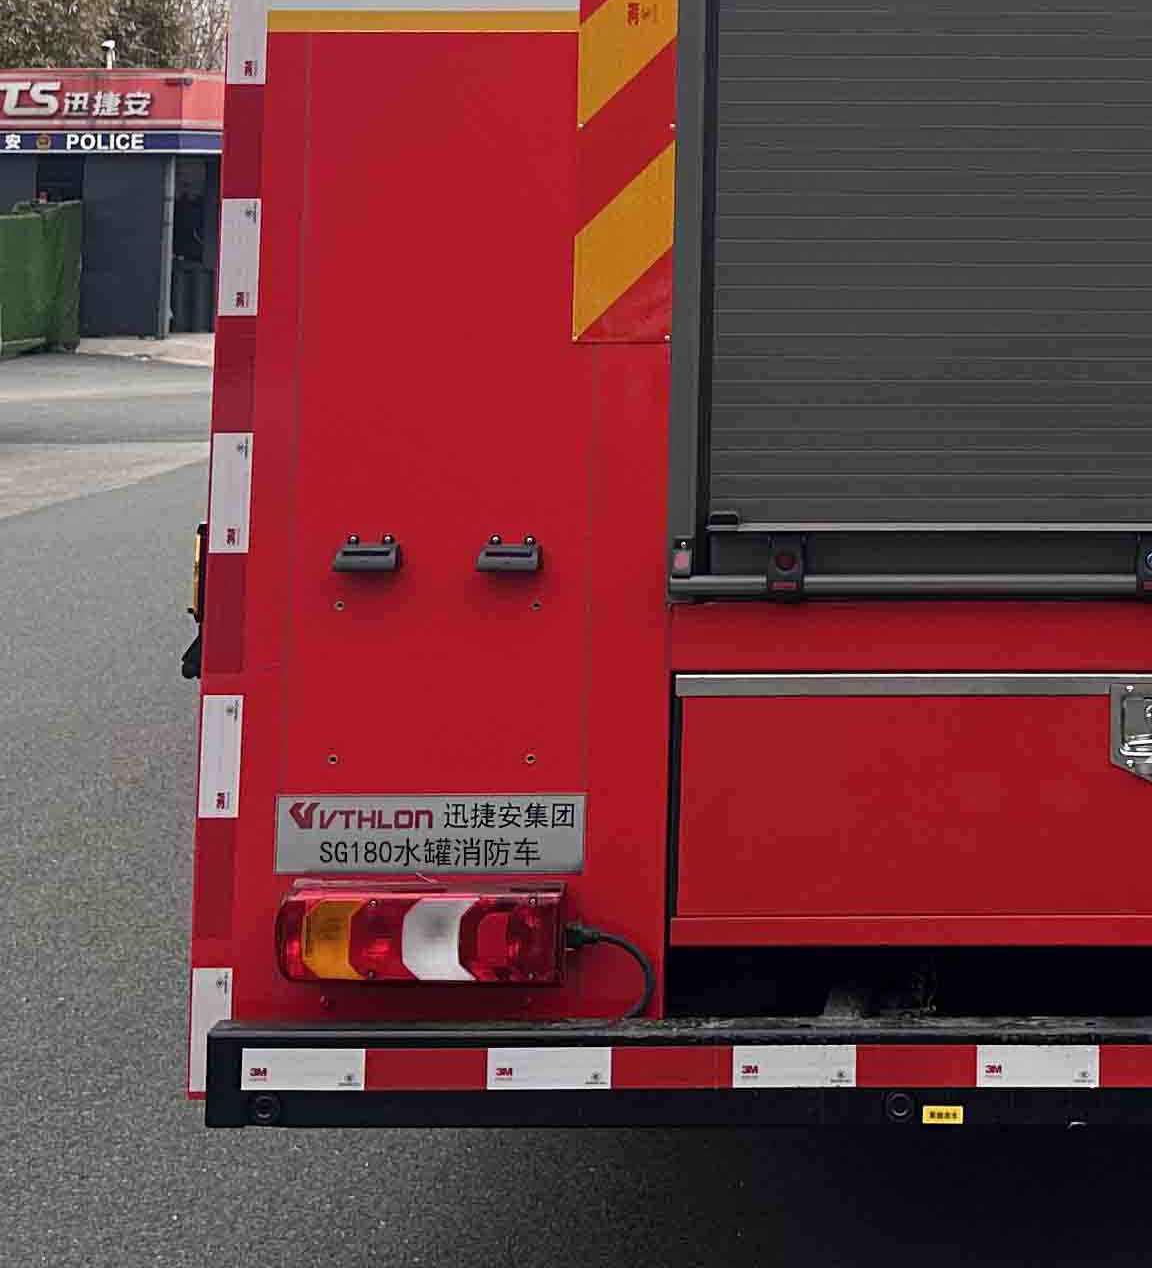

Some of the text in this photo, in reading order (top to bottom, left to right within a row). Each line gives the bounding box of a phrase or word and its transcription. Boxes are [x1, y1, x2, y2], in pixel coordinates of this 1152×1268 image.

[62, 91, 151, 116] 迅捷安
[5, 134, 145, 150] 安 POLICE
[443, 802, 576, 829] 迅捷安集团
[319, 837, 541, 867] SG180水罐消防车
[251, 1068, 267, 1076] 3M
[496, 1068, 512, 1076] 3M
[985, 1065, 1000, 1073] 3M
